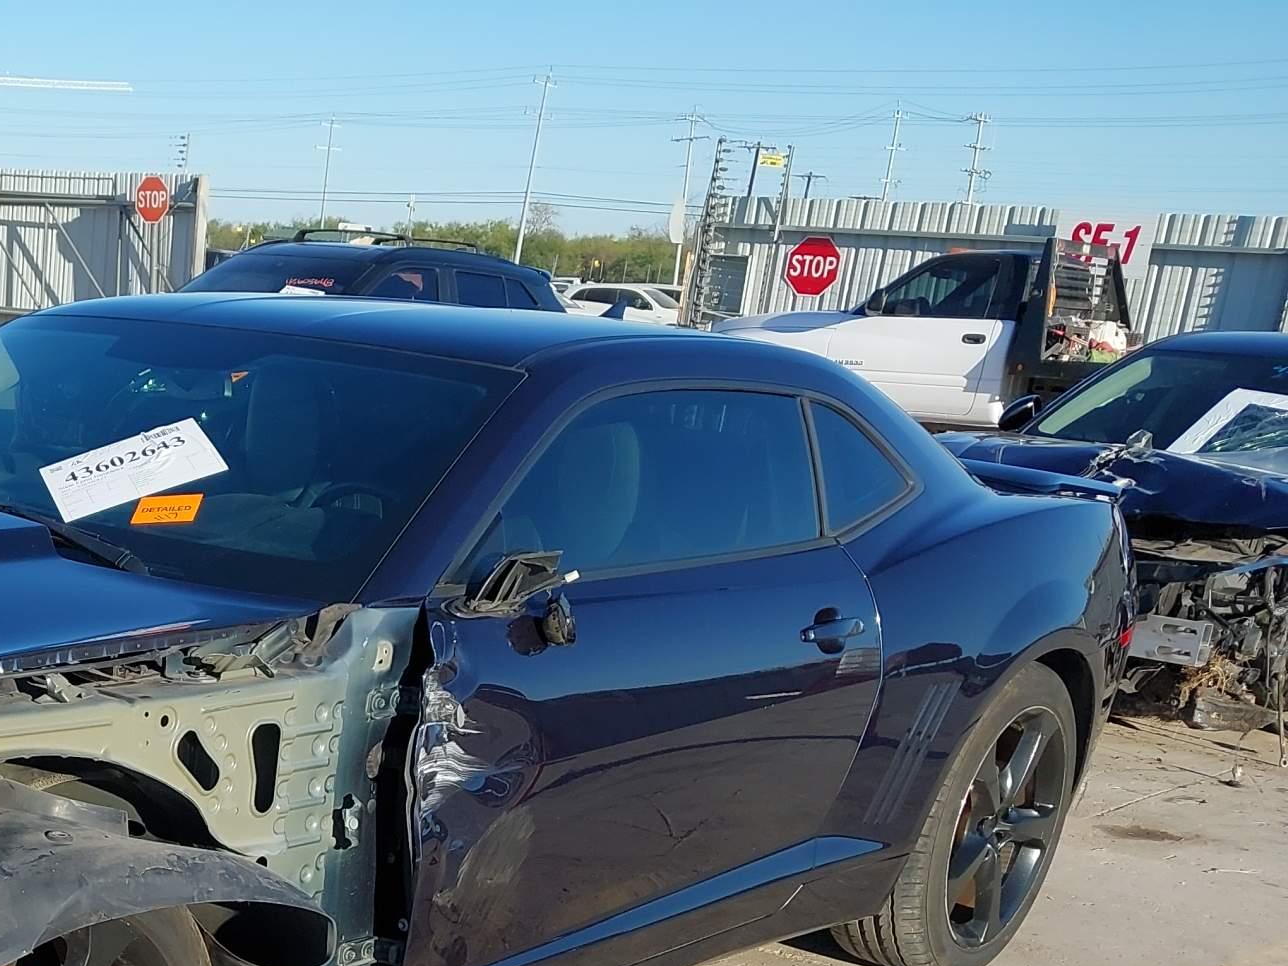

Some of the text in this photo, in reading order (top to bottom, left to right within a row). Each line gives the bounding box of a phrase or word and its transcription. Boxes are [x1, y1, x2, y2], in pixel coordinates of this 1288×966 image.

[138, 190, 167, 208] STOP
[789, 254, 838, 278] STOP
[65, 436, 186, 484] 43602643
[141, 505, 192, 513] DETAILED
